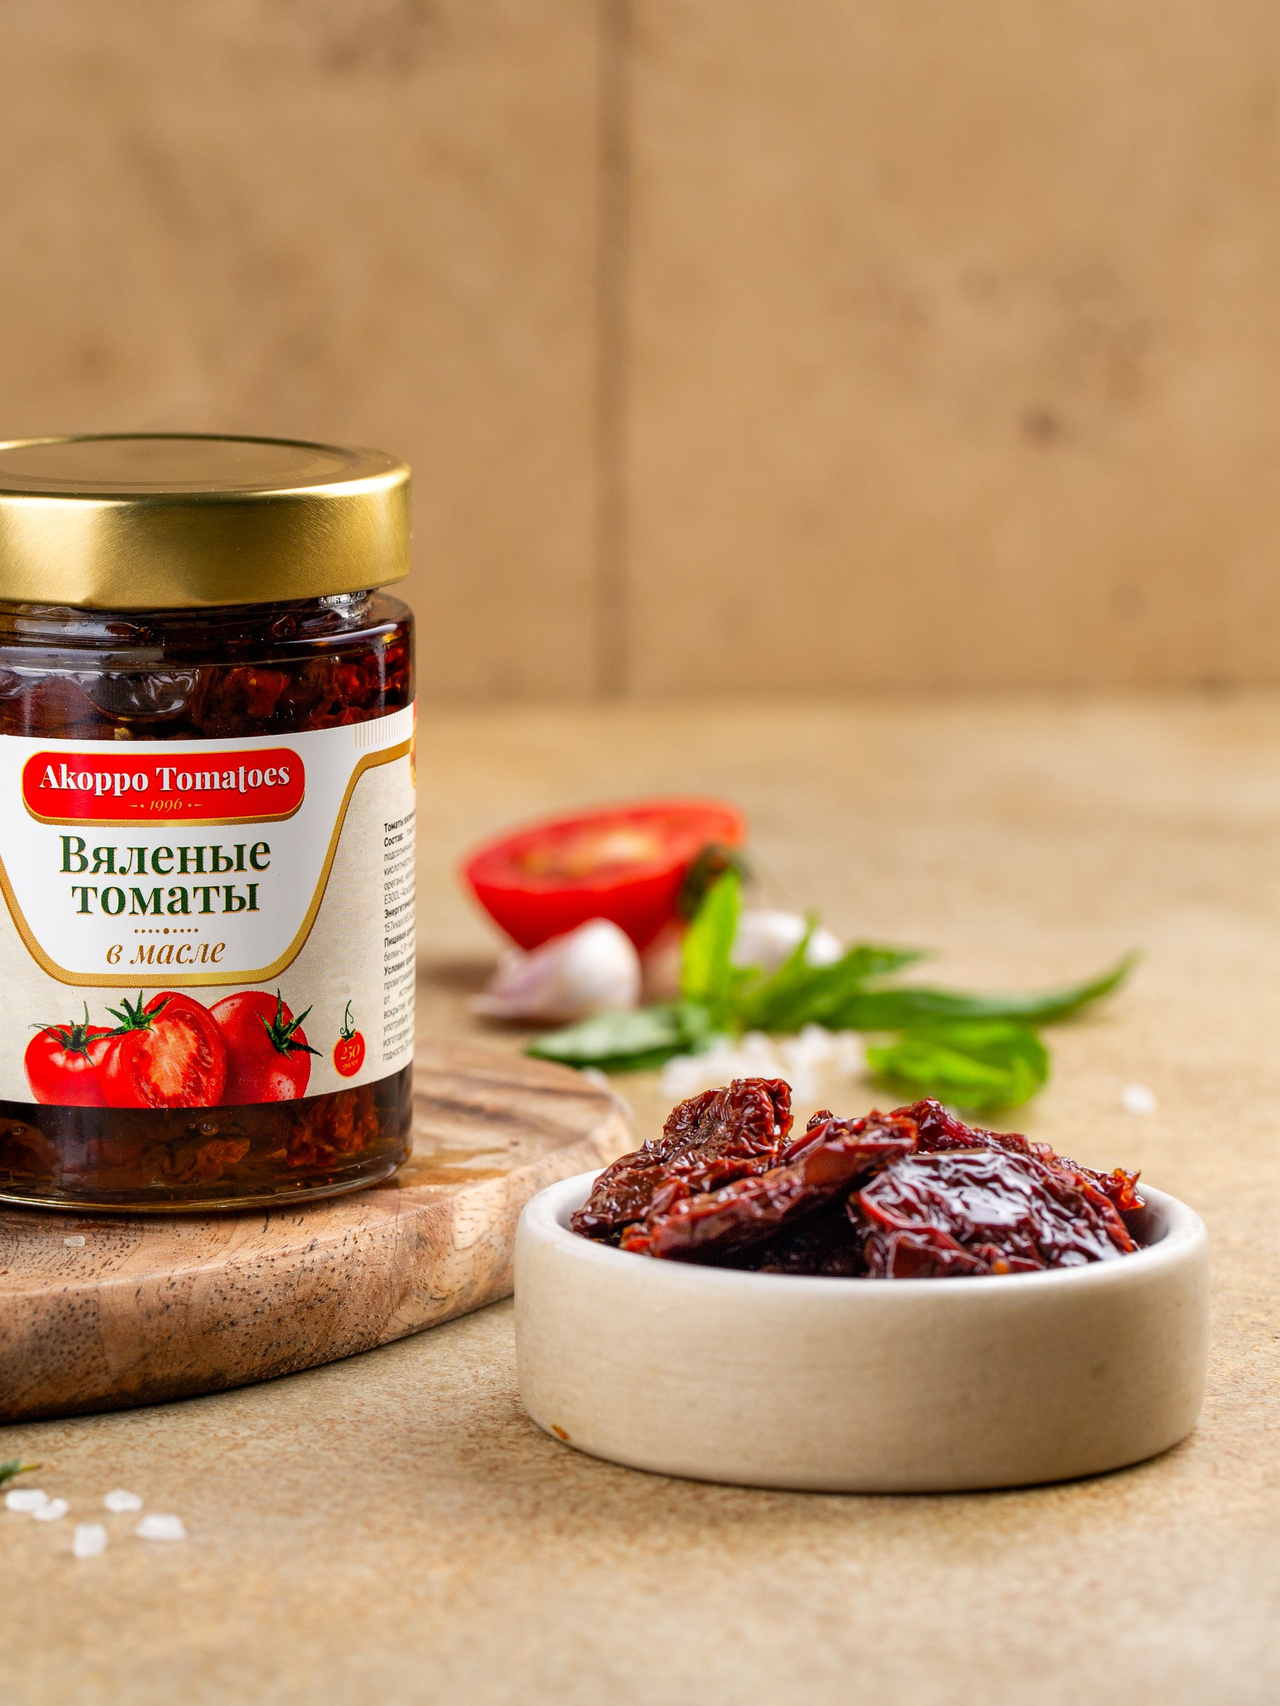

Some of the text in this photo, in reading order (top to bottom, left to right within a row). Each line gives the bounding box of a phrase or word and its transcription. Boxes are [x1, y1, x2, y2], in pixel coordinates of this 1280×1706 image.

[39, 764, 290, 797] Akoppo Tomatoes
[150, 798, 183, 812] 1996
[59, 835, 272, 876] Вяленые
[72, 883, 261, 917] томаты
[106, 941, 226, 965] в масле
